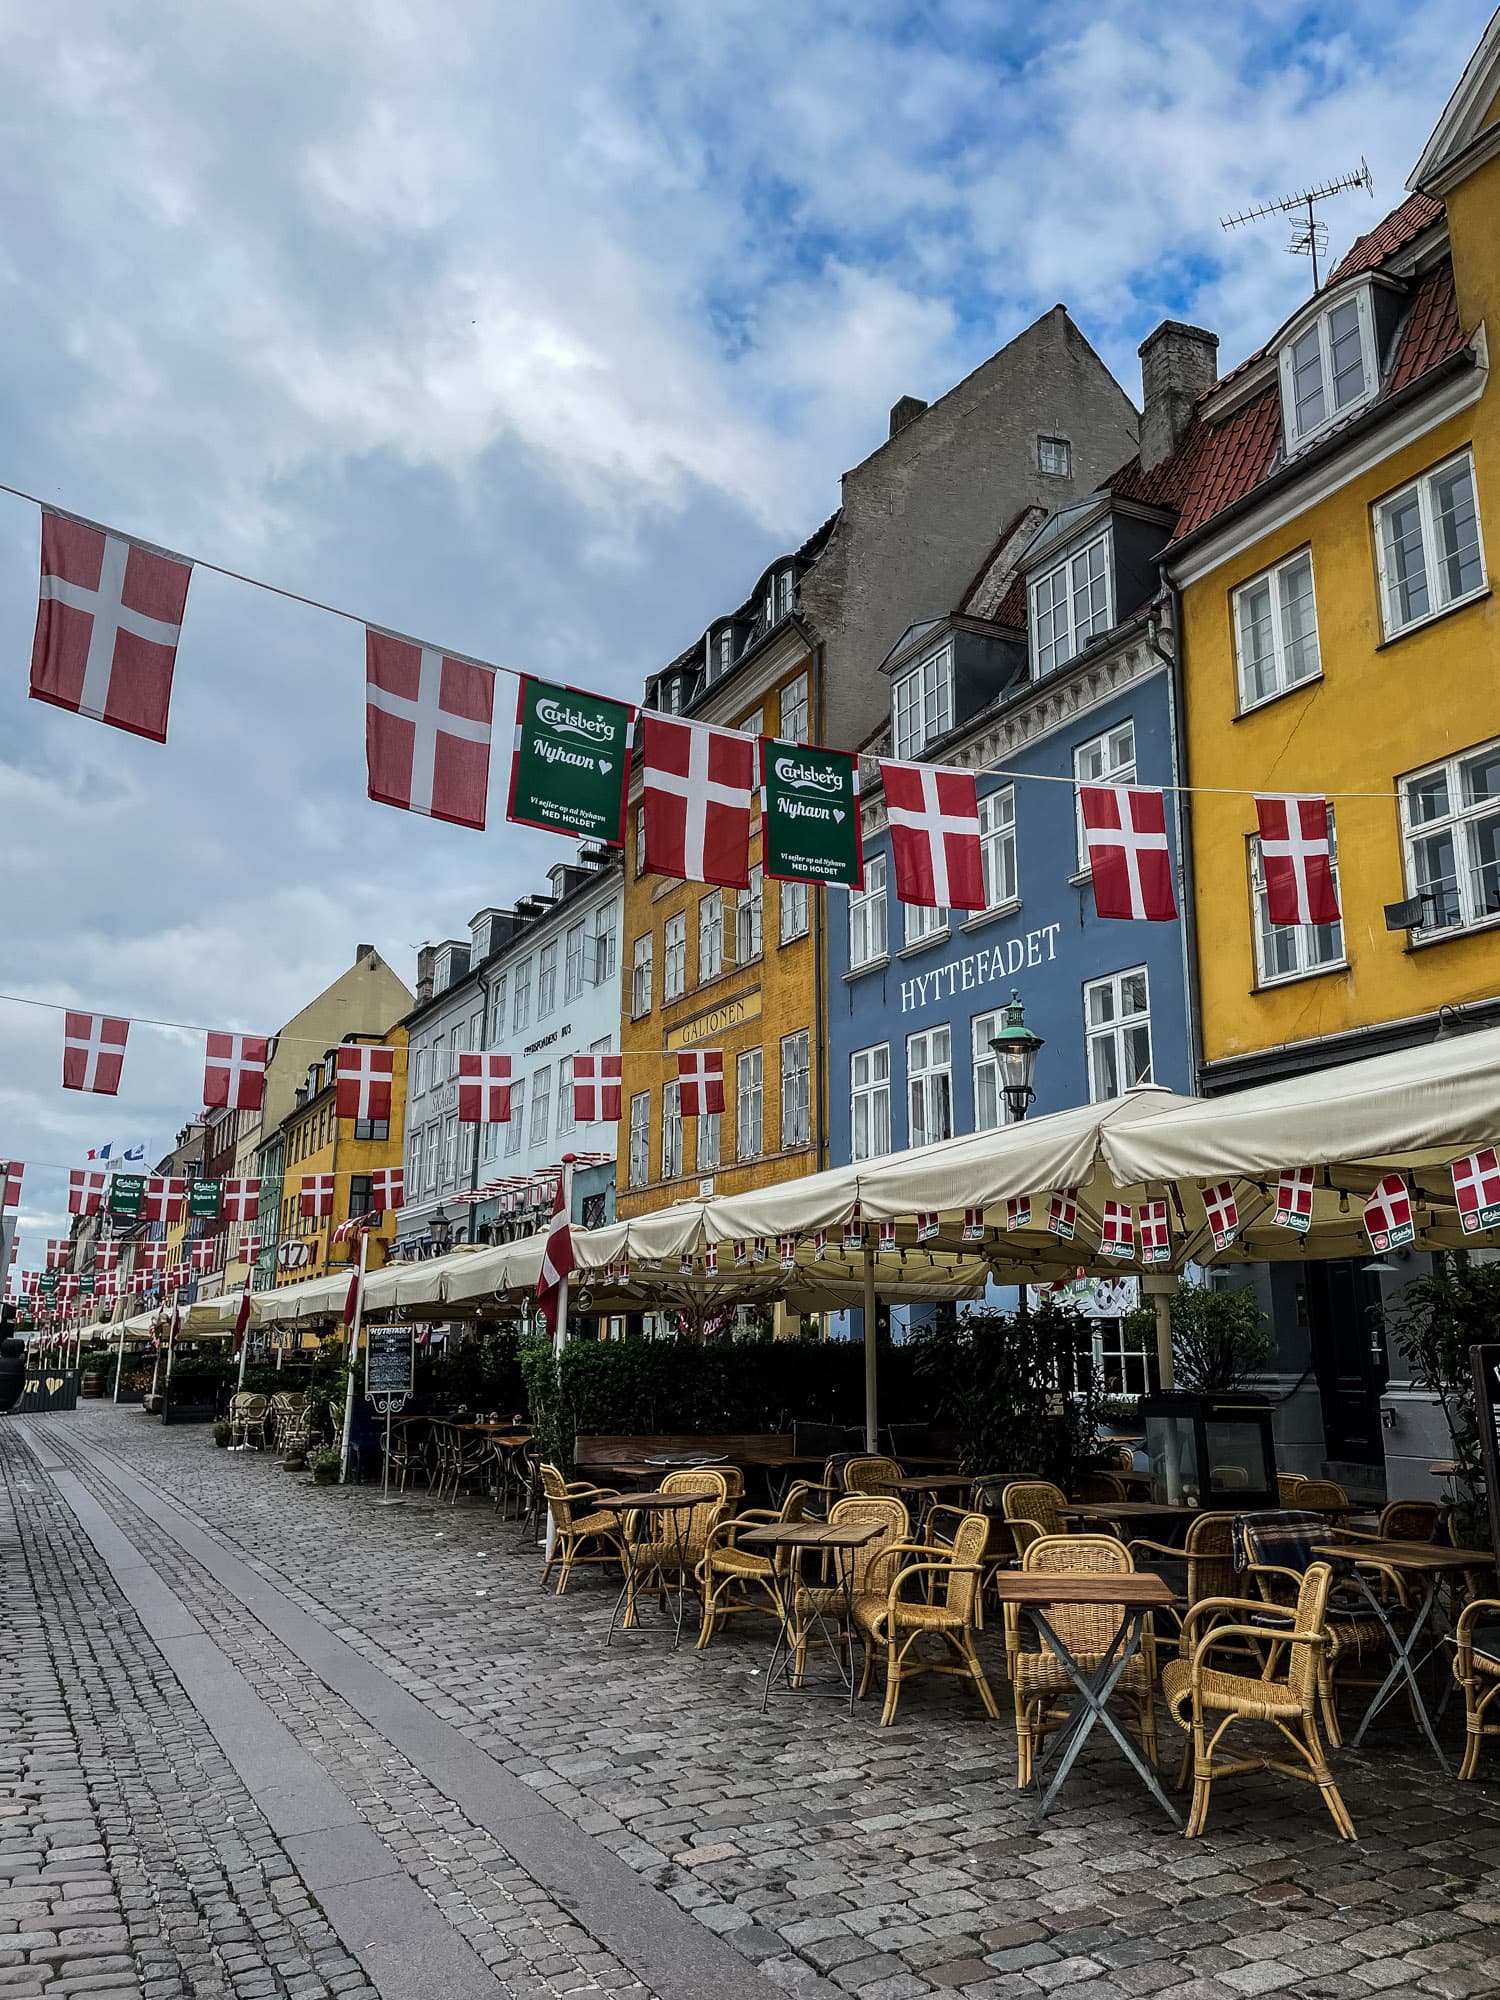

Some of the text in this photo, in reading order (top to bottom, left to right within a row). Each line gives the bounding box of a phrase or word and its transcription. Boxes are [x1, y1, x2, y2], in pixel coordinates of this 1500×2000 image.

[536, 698, 615, 742] Carlsberg
[533, 739, 594, 770] Nyhavn
[775, 757, 843, 792] Carlsberg
[541, 809, 596, 829] MED HOLDET
[579, 809, 606, 822] Nyhavn
[777, 797, 830, 820] Nyhavn
[792, 863, 838, 875] MED HOLDET
[900, 922, 1061, 1013] HYTTEFADET
[280, 1243, 305, 1266] 17
